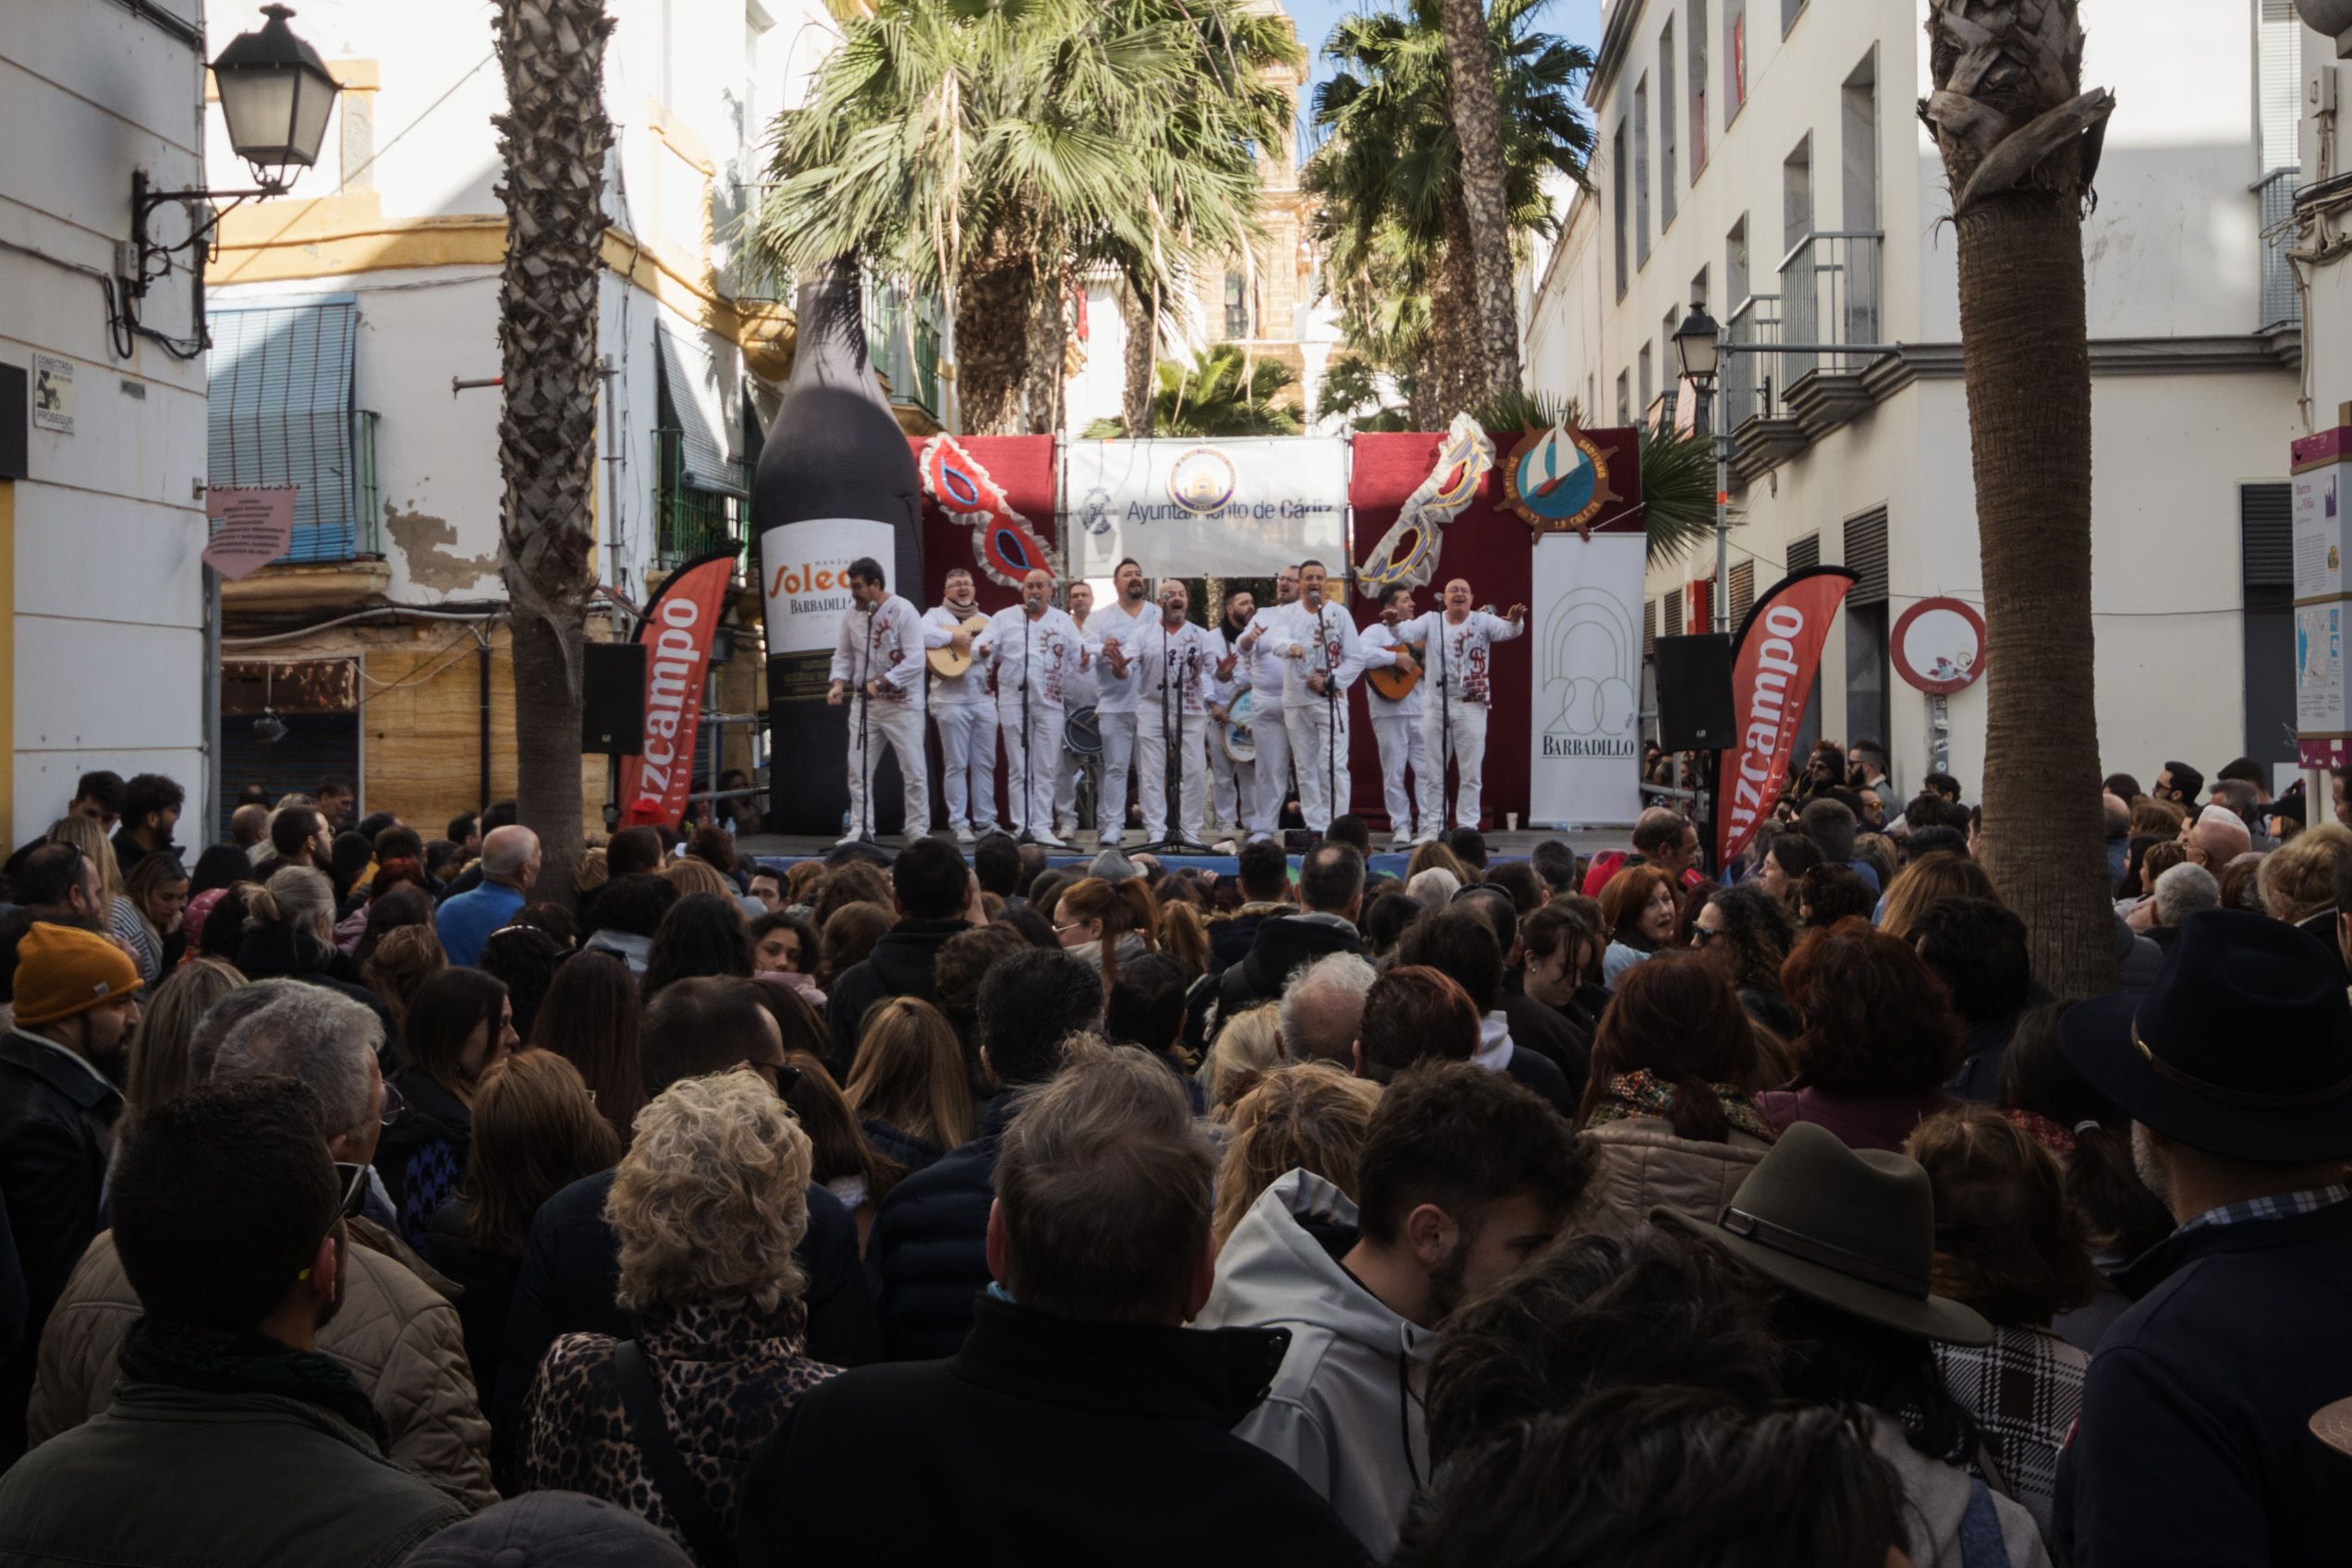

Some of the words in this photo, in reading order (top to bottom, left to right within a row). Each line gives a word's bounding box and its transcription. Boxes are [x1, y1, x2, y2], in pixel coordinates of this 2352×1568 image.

[1253, 500, 1275, 519] de
[790, 597, 852, 614] BARBADILL
[1542, 735, 1635, 756] BARBADILLO
